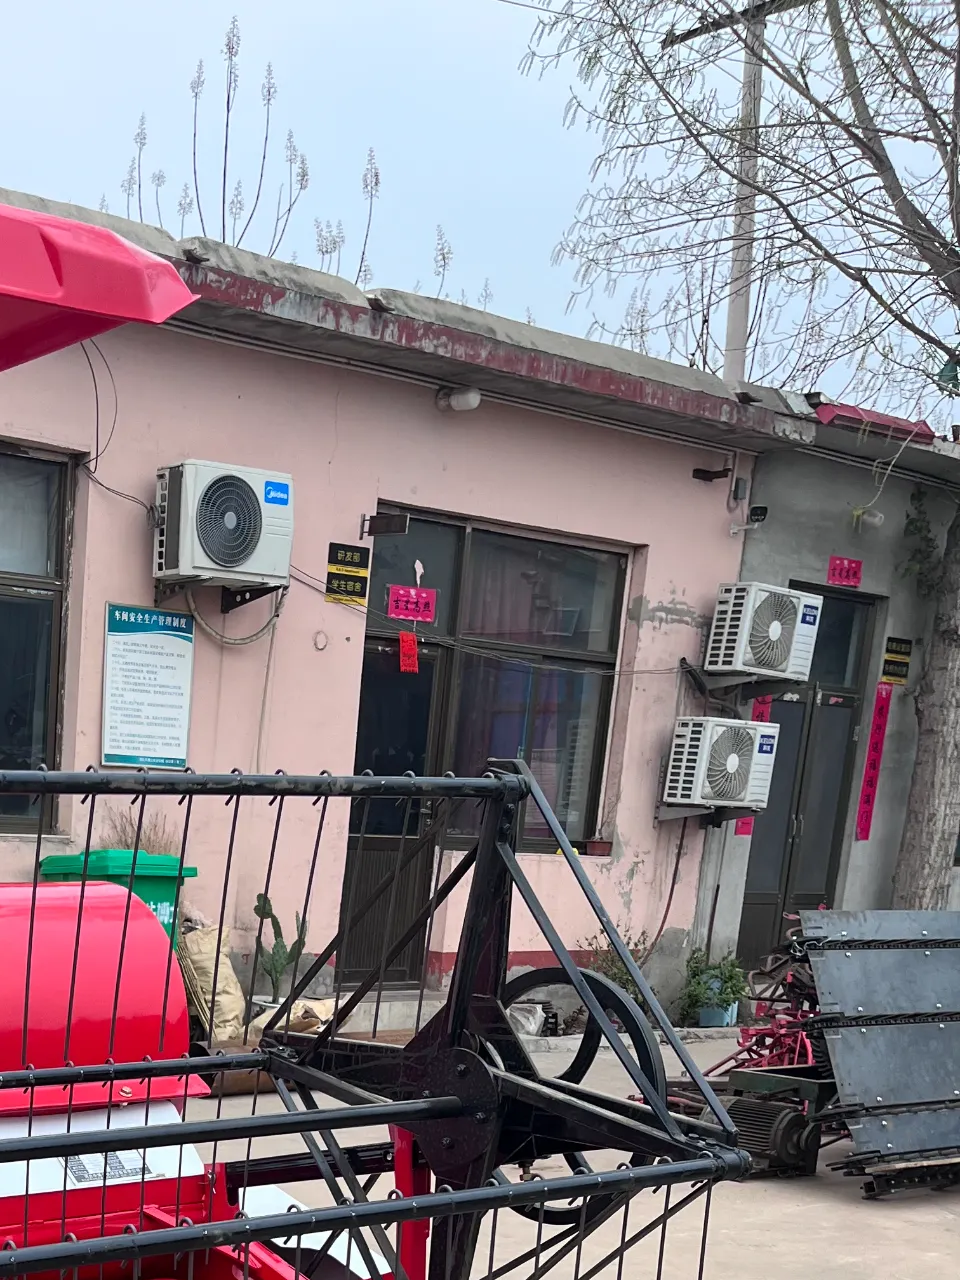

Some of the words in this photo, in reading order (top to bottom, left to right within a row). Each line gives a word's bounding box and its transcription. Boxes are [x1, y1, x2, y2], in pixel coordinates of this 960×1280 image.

[114, 610, 187, 629] 车间安全生产管理制度
